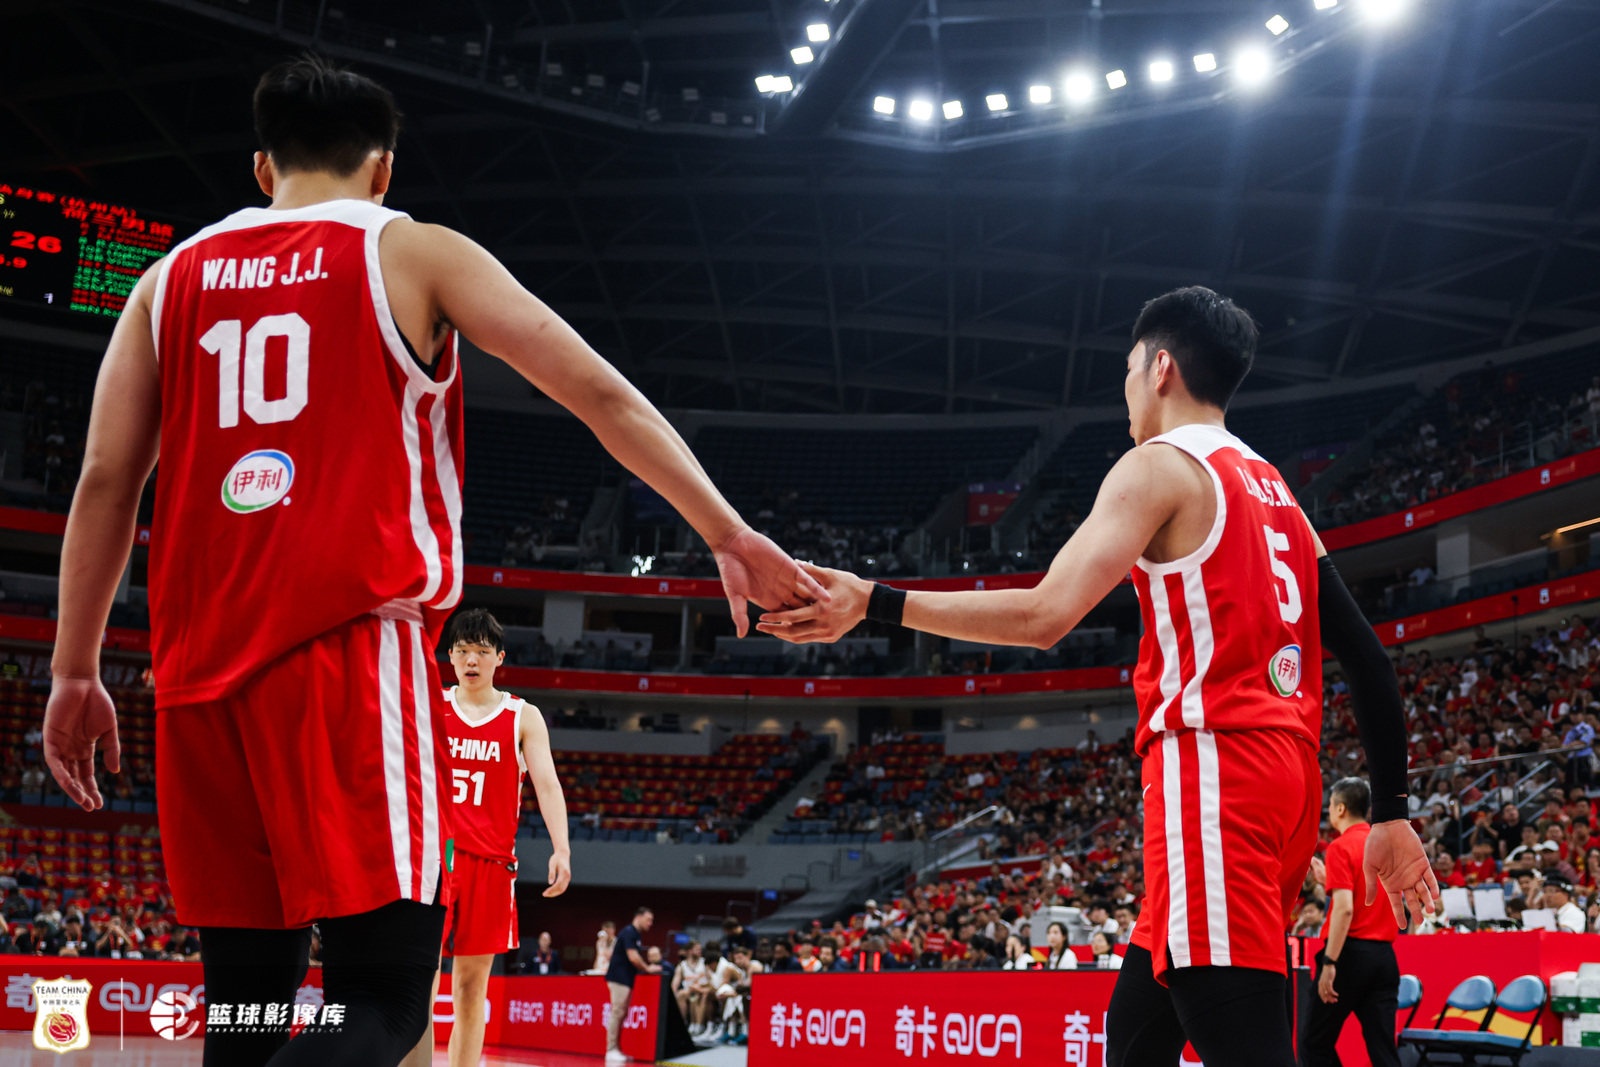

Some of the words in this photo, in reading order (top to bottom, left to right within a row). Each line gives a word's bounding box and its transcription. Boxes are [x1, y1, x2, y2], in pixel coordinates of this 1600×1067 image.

[10, 231, 62, 253] 26
[202, 256, 276, 290] WANG
[280, 247, 328, 285] J.J.
[199, 312, 311, 428] 10
[233, 468, 283, 495] 伊利
[1263, 524, 1303, 624] 5
[451, 769, 485, 806] 51
[770, 1003, 803, 1048] 奇卡
[895, 1005, 938, 1058] 奇卡
